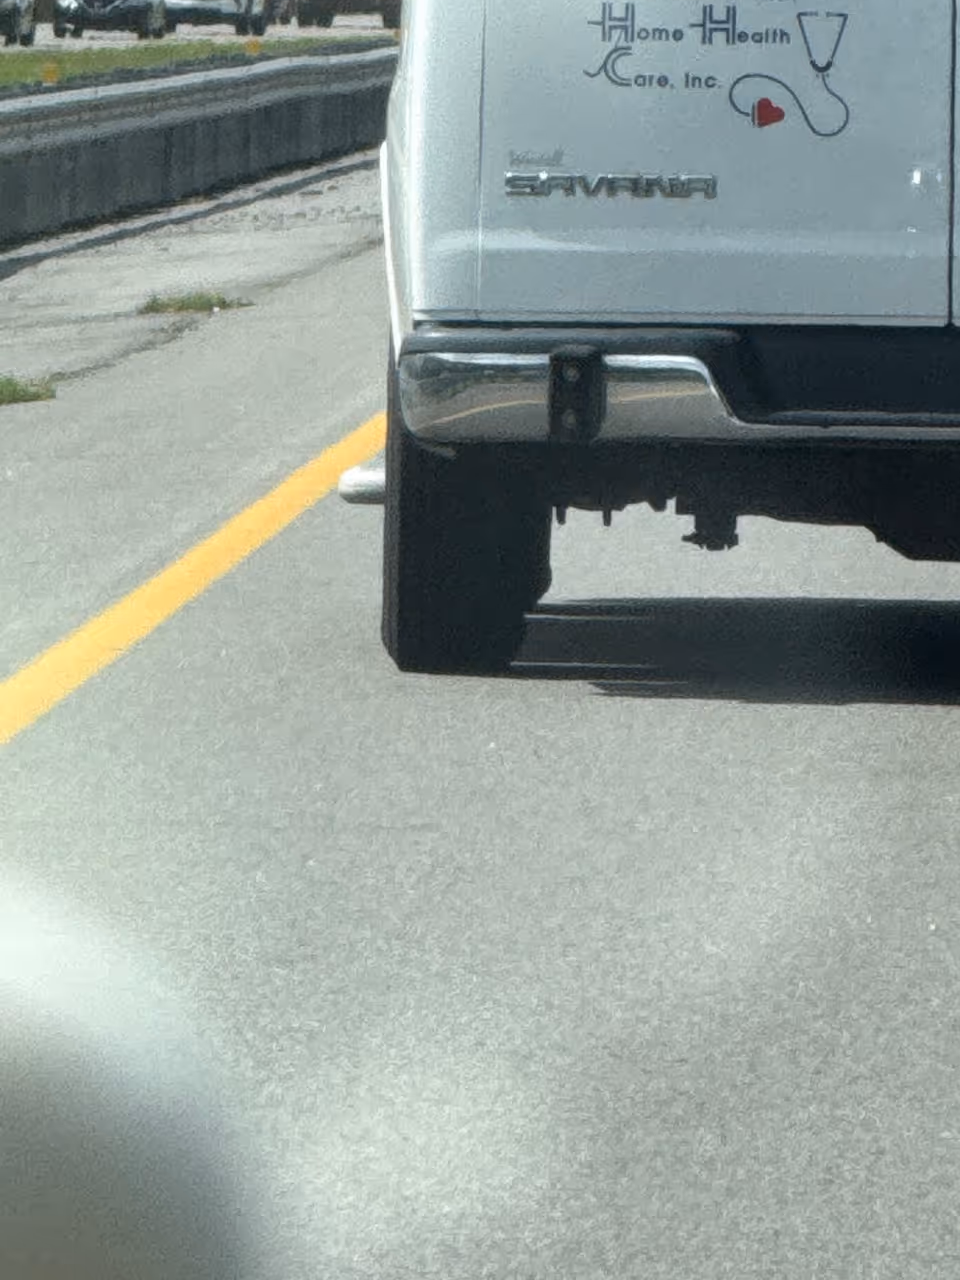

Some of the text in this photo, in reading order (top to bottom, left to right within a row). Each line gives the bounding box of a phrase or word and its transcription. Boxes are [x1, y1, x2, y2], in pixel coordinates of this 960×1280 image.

[588, 2, 790, 45] Home Health
[684, 73, 723, 89] Inc.
